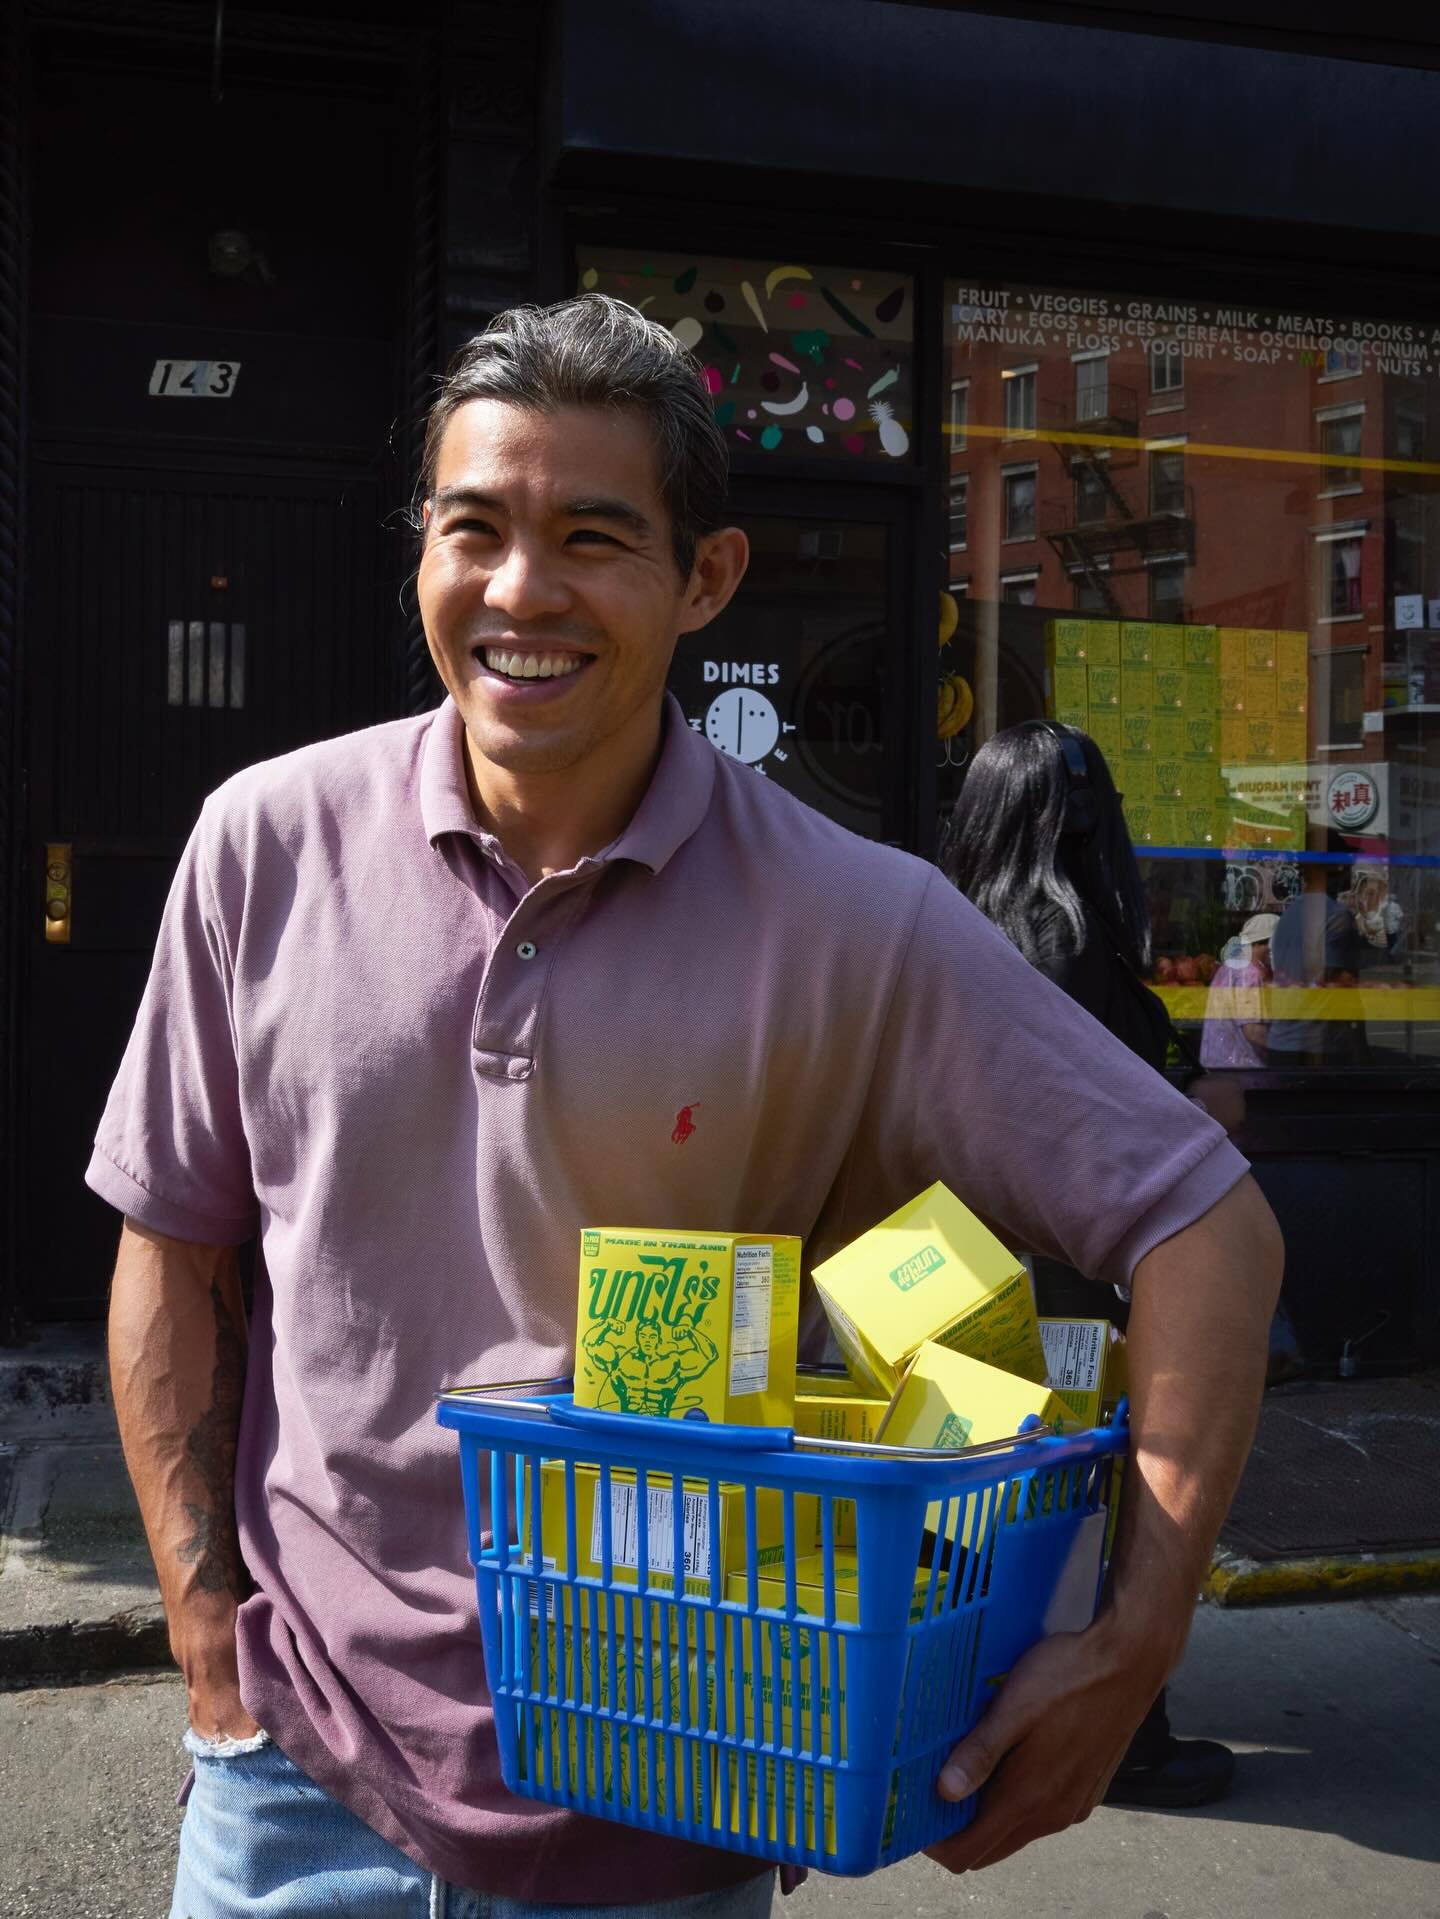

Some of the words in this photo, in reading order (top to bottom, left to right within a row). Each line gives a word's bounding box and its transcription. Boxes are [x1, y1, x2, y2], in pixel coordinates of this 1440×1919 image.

[958, 288, 1011, 308] FRUIT
[1029, 294, 1108, 316] VEGGIES
[1127, 302, 1198, 322] GRAINS
[1216, 310, 1259, 329] MILK
[1277, 315, 1334, 335] MEATS
[1352, 322, 1413, 342] BOOKS
[958, 308, 1008, 325] CARY
[1028, 312, 1079, 331] EGGS
[1097, 318, 1156, 337] SPICES
[1175, 323, 1241, 343] CEREAL
[1259, 331, 1428, 360] OSCILLOCOCCINUM
[958, 325, 1047, 347] MANUKA
[1066, 332, 1121, 352] FLOSS
[1140, 338, 1216, 360] YOGURT
[1233, 346, 1281, 364] SOAP
[1377, 358, 1422, 377] NUTS
[158, 363, 233, 394] 143
[703, 660, 780, 685] DIMES
[604, 1237, 641, 1247] MADE
[643, 1239, 657, 1248] IN
[658, 1240, 728, 1252] THAILAND
[1089, 1326, 1099, 1362] Nutrition
[1065, 1369, 1073, 1385] 360
[1086, 1365, 1095, 1387] Facts
[684, 1551, 692, 1571] 360
